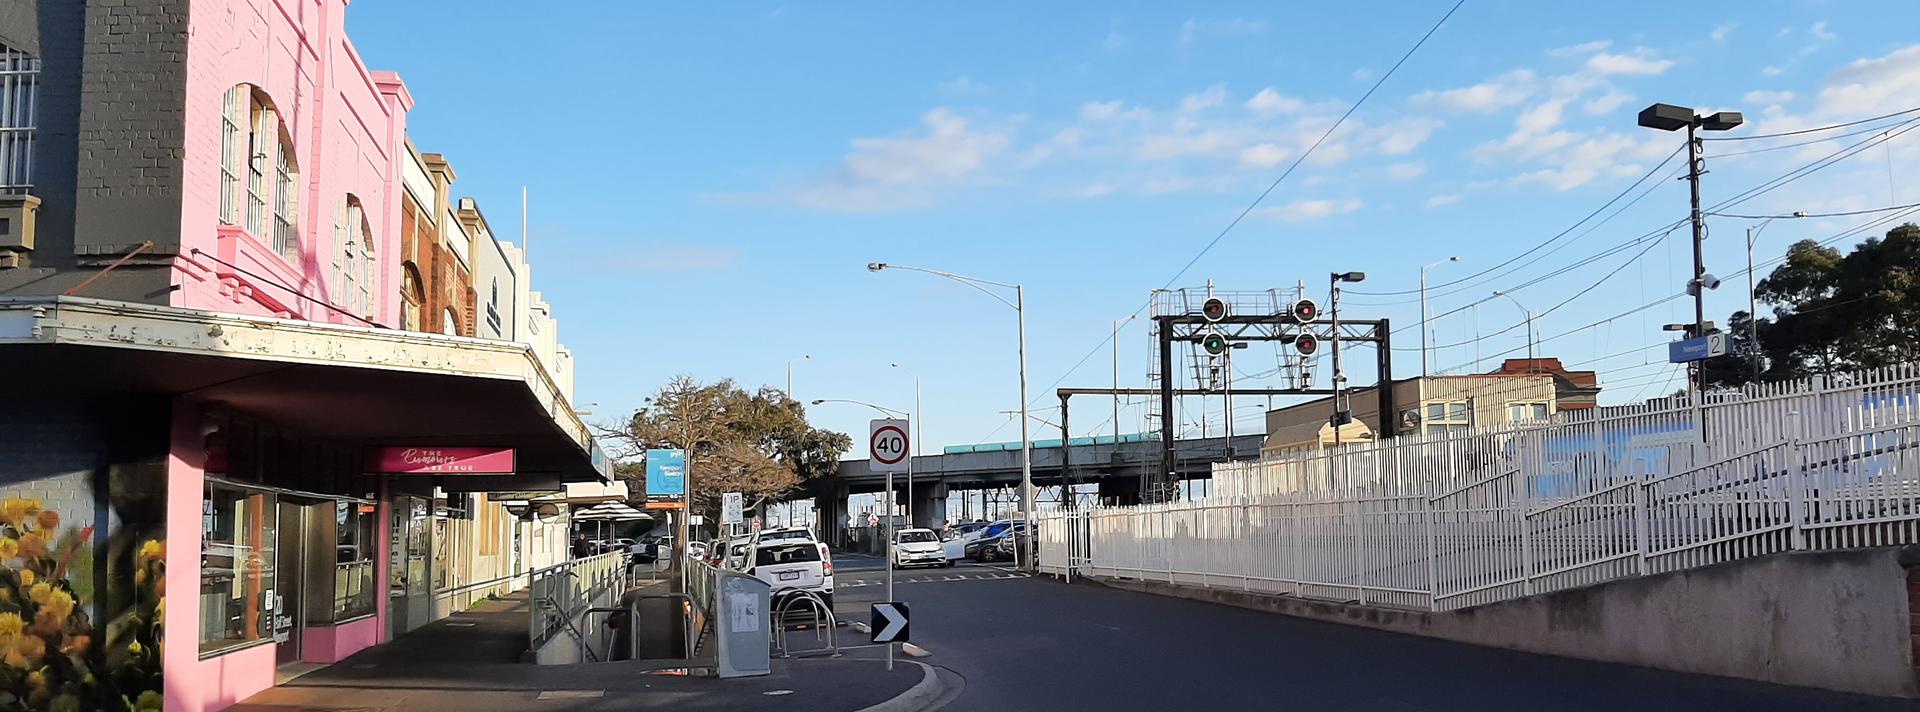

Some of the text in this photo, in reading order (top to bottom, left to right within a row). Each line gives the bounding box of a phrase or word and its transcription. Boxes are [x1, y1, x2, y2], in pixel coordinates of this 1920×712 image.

[1711, 336, 1721, 354] 2
[876, 436, 903, 454] 40
[730, 495, 740, 504] 1P
